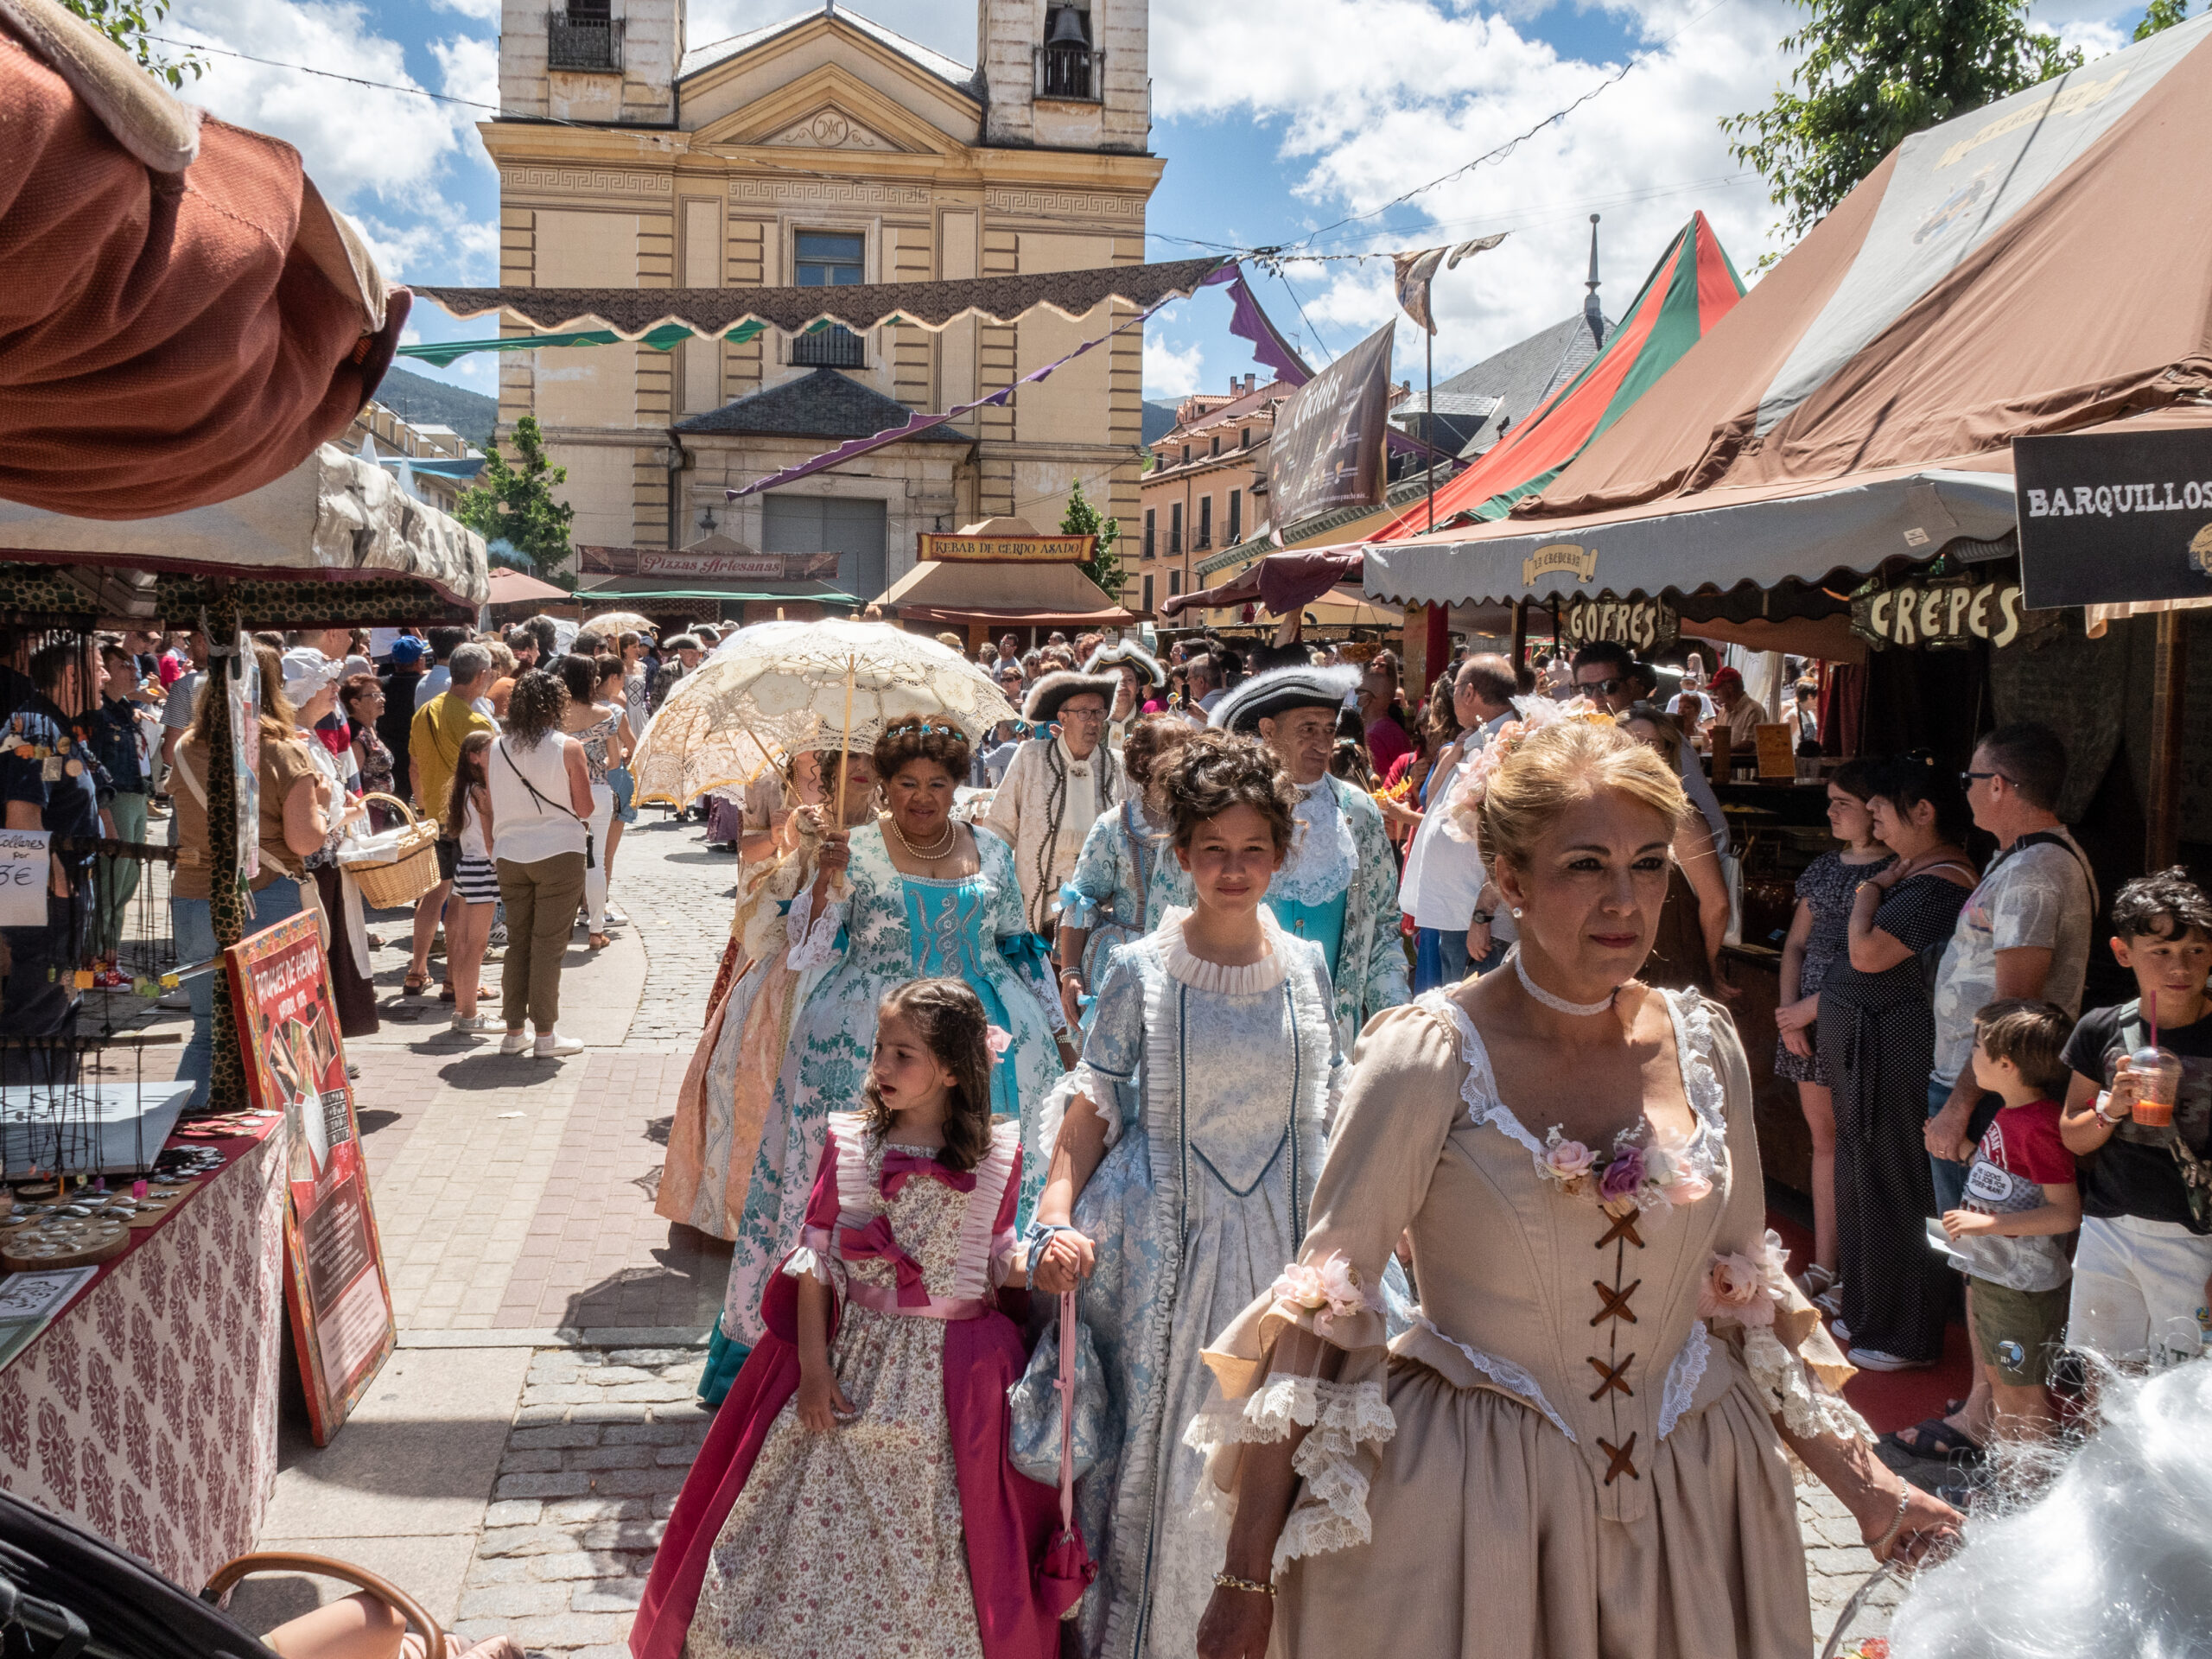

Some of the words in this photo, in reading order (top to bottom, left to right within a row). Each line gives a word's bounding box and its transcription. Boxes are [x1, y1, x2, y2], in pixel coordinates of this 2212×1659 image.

[2026, 480, 2212, 518] BARQUILLOS
[641, 552, 697, 571] Pizzas
[699, 555, 780, 575] Artesanas
[935, 541, 976, 554] KEBAB
[980, 543, 994, 554] DE
[998, 543, 1036, 556] CERDO
[1040, 543, 1079, 555] ASADO
[1570, 602, 1656, 649] GOFRES
[1870, 582, 2021, 649] CREPES
[255, 960, 286, 1005] TATUAJES
[286, 955, 296, 988] DE
[296, 944, 321, 982] HENNA
